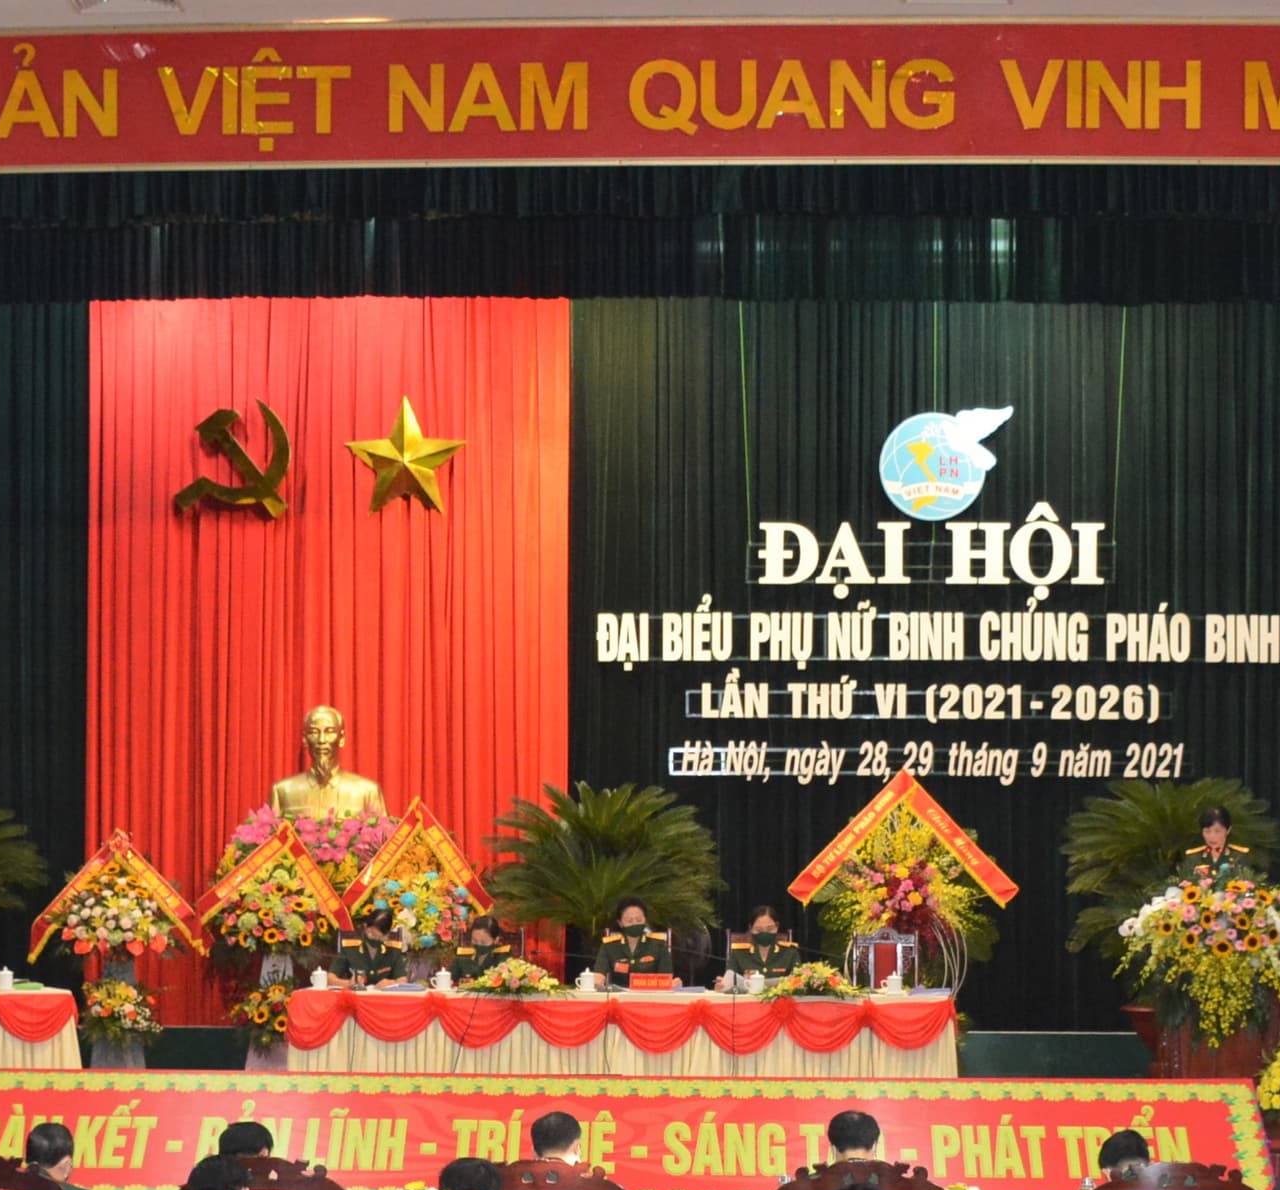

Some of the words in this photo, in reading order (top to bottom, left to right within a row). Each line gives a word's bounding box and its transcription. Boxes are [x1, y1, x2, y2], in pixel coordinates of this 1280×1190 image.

[157, 47, 352, 151] VIỆT
[388, 61, 589, 133] NAM
[629, 59, 956, 135] QUANG
[1000, 59, 1202, 129] VINH
[935, 485, 960, 497] NAM
[758, 521, 911, 600] ĐẠI
[945, 501, 1106, 601] HỘI
[596, 612, 650, 672] ĐẠI
[662, 593, 733, 662] BIỂU
[750, 612, 813, 671] PHỤ
[827, 600, 877, 662] NỮ
[888, 612, 965, 662] BINH
[979, 596, 1090, 662] CHỦNG
[1106, 602, 1191, 663] PHÁO
[1205, 613, 1280, 664] BINH
[701, 667, 769, 719] LẦN
[787, 675, 857, 720] THỨ
[874, 683, 908, 720] VI
[681, 740, 715, 777] Hà
[725, 740, 771, 783] Nội,
[784, 741, 847, 785] ngày
[856, 740, 892, 783] 28,
[901, 740, 935, 777] 29
[948, 741, 1019, 787] tháng
[1030, 741, 1048, 778] 9
[1058, 742, 1113, 778] năm
[1123, 742, 1185, 778] 2021
[74, 1099, 158, 1169] KẾT
[195, 1099, 293, 1166] BN
[303, 1107, 409, 1171] LĨNH
[452, 1109, 525, 1165] TRÍ
[662, 1111, 787, 1177] SÁNG
[930, 1114, 1048, 1179] PHÁT
